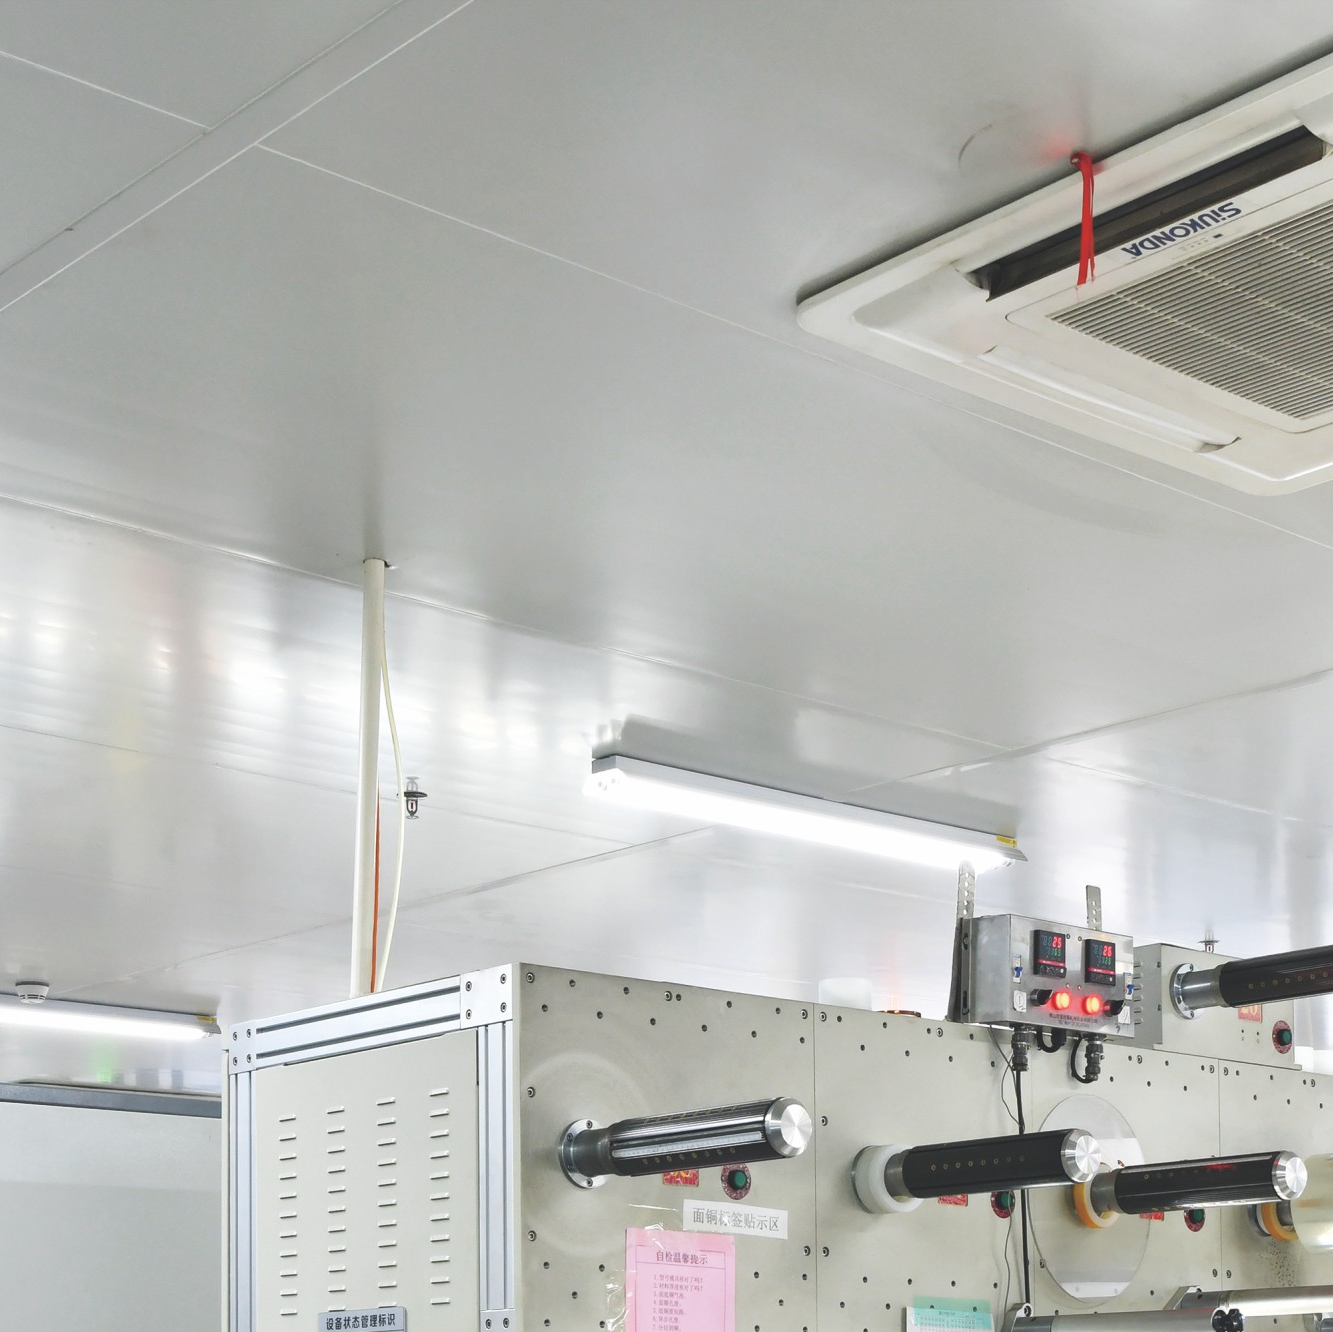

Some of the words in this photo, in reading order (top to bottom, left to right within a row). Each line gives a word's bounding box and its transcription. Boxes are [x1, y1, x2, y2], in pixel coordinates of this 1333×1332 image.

[656, 1250, 708, 1265] 自检温馨提示
[326, 1313, 396, 1331] 设备状态管理标识
